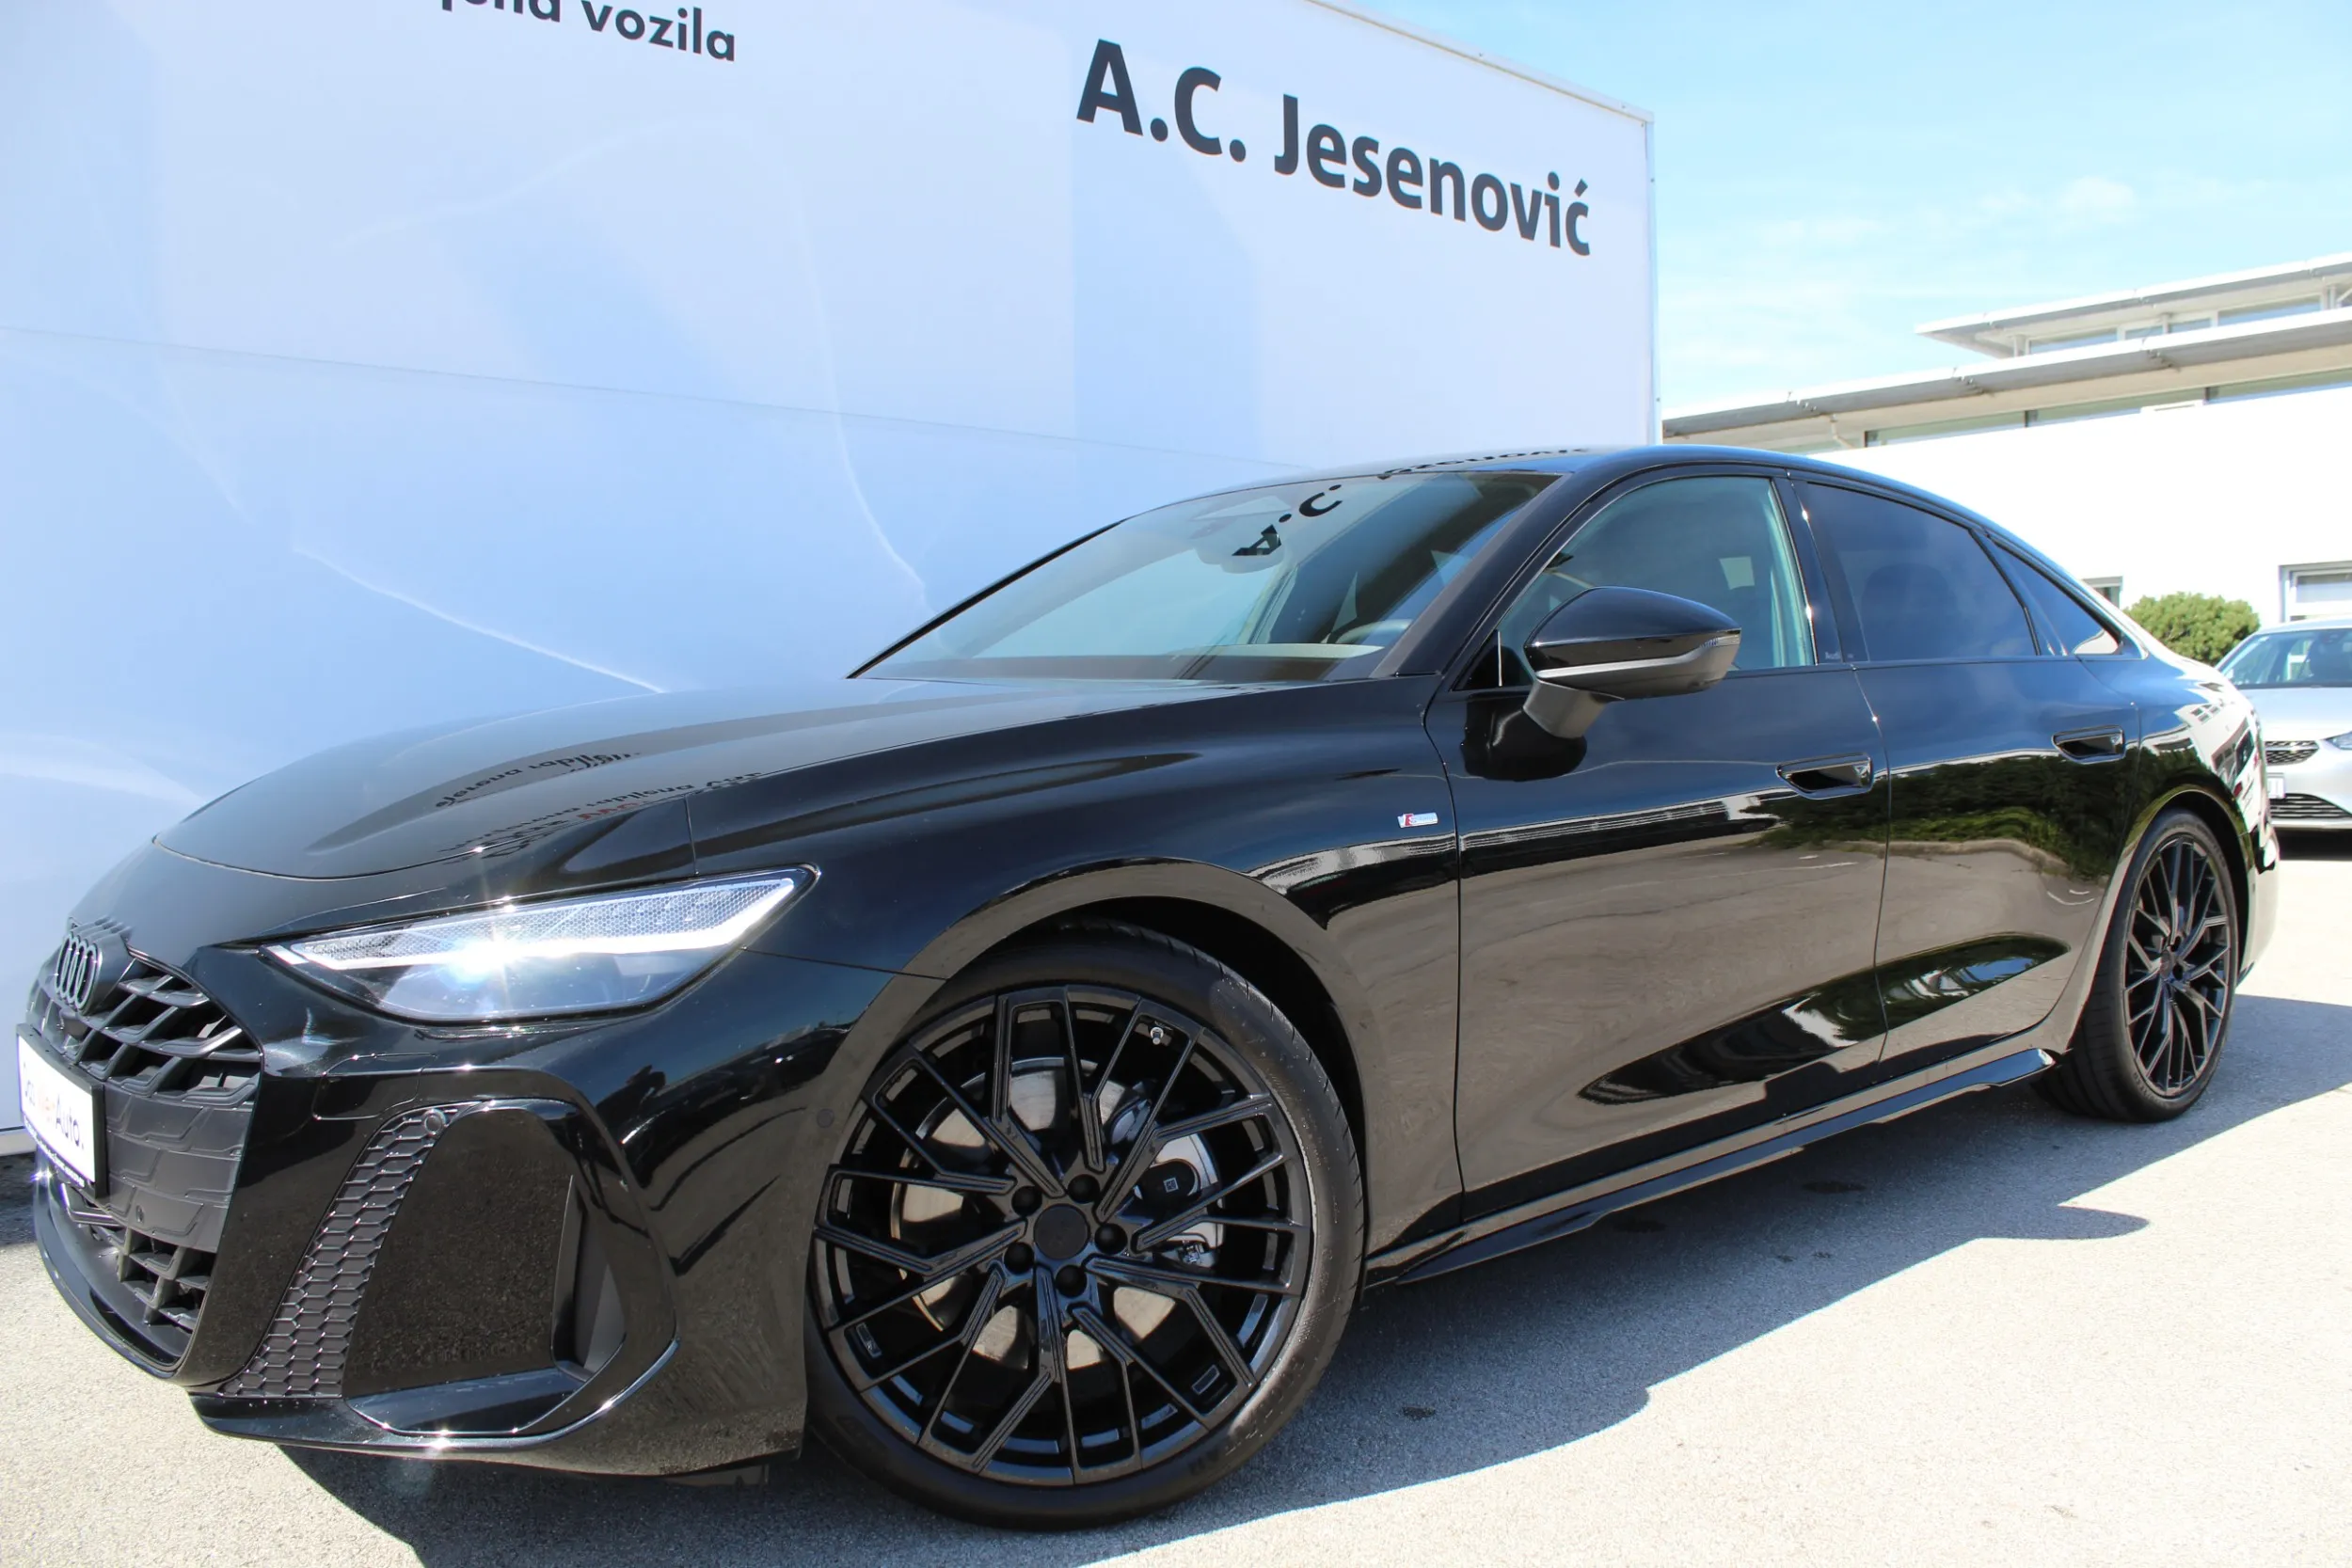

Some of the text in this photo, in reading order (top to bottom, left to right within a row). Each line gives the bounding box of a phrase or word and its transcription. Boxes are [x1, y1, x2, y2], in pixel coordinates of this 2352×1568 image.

[580, 0, 735, 62] vozila
[1076, 39, 1590, 256] A.C. Jesenović
